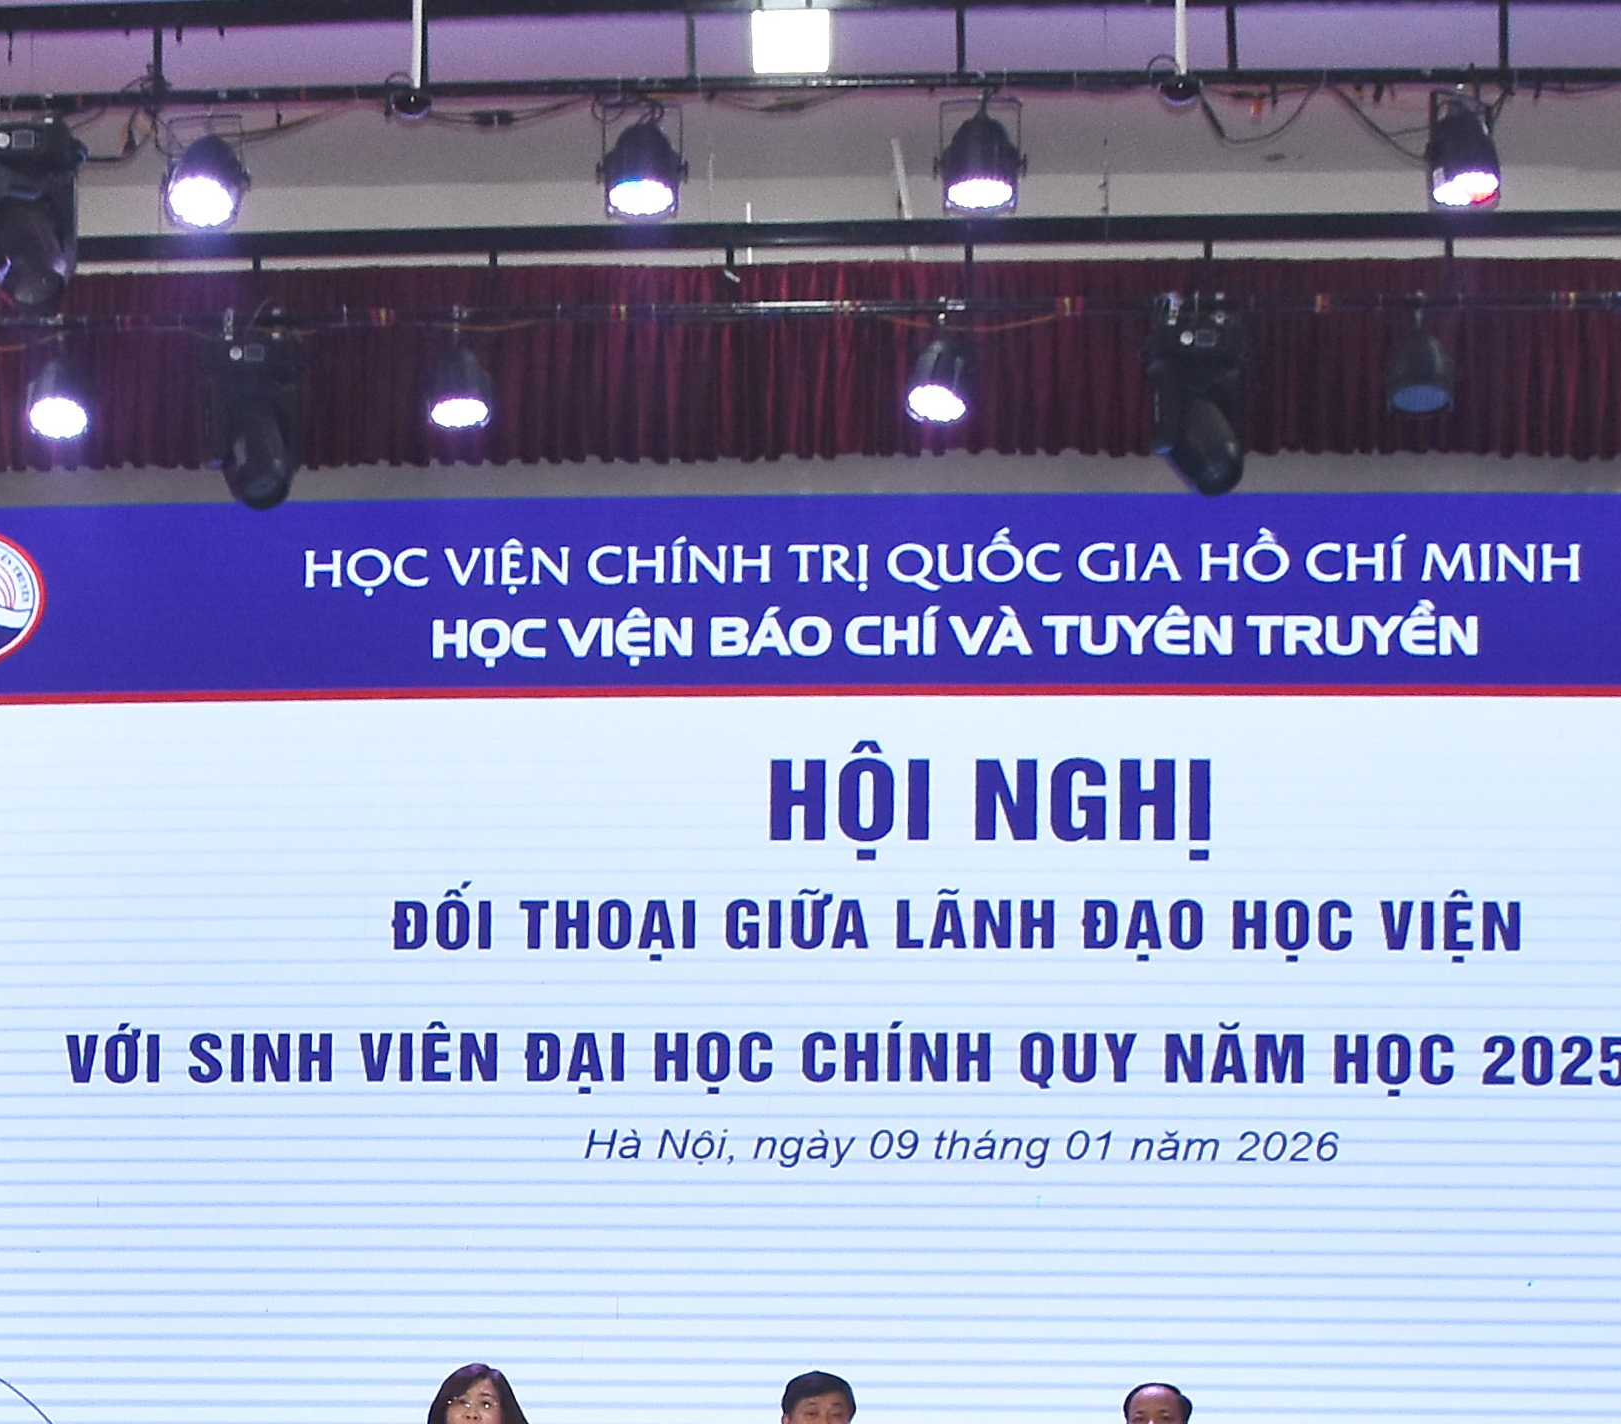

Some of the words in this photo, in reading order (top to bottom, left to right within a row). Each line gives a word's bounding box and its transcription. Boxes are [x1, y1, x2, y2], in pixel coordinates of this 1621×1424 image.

[305, 548, 429, 596] HỌC
[445, 539, 569, 594] VIỆN
[588, 536, 770, 584] CHÍNH
[788, 544, 868, 591] TRỊ
[888, 527, 1062, 590] QUỐC
[1079, 543, 1181, 581] GIA
[1201, 528, 1289, 581] HỒ
[1306, 534, 1406, 582] CHÍ
[1422, 543, 1580, 582] MINH
[433, 619, 546, 667] HỌC
[558, 607, 692, 666] VIỆN
[711, 606, 832, 656] BÁO
[846, 606, 940, 655] CHÍ
[949, 606, 1032, 655] VÀ
[1042, 605, 1232, 655] TUYÊN
[1247, 598, 1478, 655] TRUYỀN
[771, 741, 929, 860] HỘI
[975, 758, 1210, 860] NGHỊ
[392, 882, 491, 950] ĐỐI
[520, 900, 695, 961] THOẠI
[726, 889, 868, 949] GIỮA
[897, 889, 1054, 948] LÃNH
[1083, 900, 1203, 961] ĐẠO
[1233, 900, 1352, 962] HỌC
[1381, 890, 1520, 963] VIỆN
[66, 1023, 159, 1083] VỚI
[189, 1033, 332, 1083] SINH
[360, 1022, 497, 1081] VIÊN
[525, 1033, 624, 1094] ĐẠI
[655, 1032, 772, 1094] HỌC
[802, 1021, 990, 1082] CHÍNH
[1020, 1032, 1136, 1089] QUY
[1165, 1022, 1304, 1083] NĂM
[1334, 1034, 1454, 1096] HỌC
[585, 1129, 641, 1159] Hà
[658, 1129, 734, 1165] Nội,
[754, 1129, 855, 1168] ngày
[870, 1130, 919, 1159] 09
[935, 1130, 1050, 1168] tháng
[1067, 1130, 1112, 1160] 01
[1131, 1131, 1219, 1161] năm
[1237, 1131, 1339, 1161] 2026
